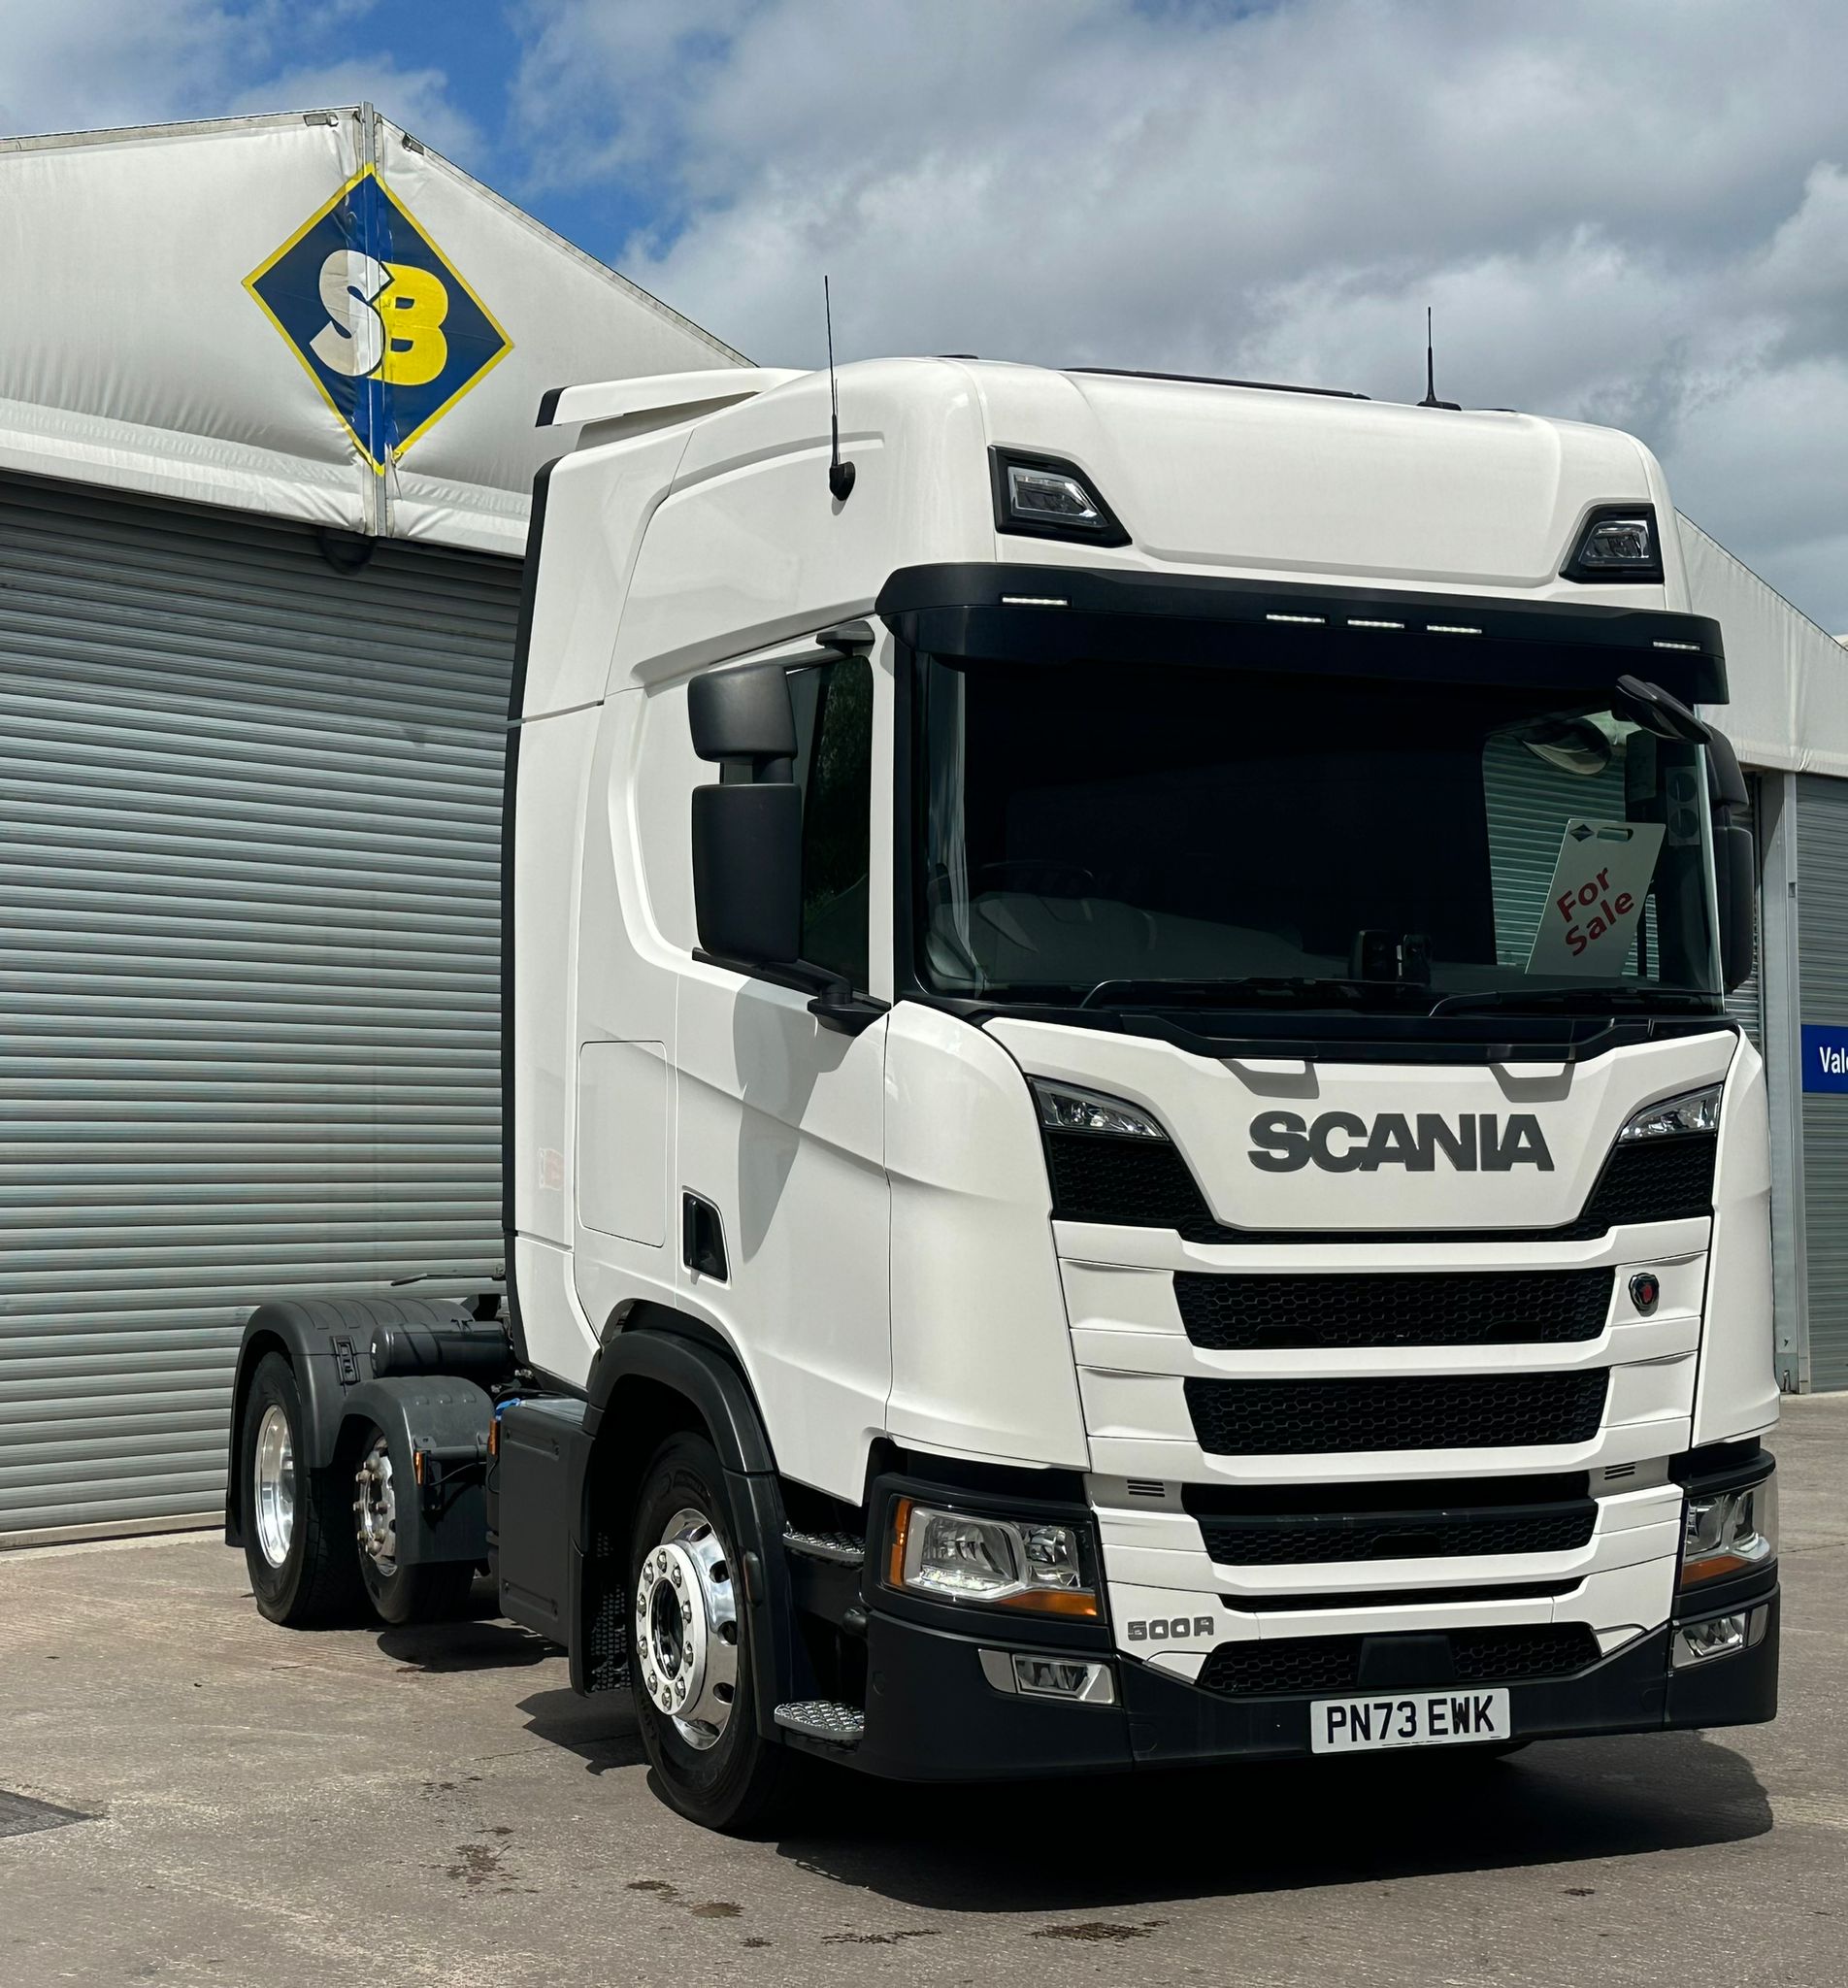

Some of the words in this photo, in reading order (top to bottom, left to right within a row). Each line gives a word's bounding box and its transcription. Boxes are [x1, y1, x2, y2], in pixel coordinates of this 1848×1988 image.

[309, 248, 448, 386] SB
[1557, 868, 1609, 922] For
[1566, 893, 1634, 956] Sale
[1247, 1110, 1555, 1173] SCANIA
[1127, 1616, 1214, 1640] 500R
[1326, 1701, 1417, 1744] PN73
[1427, 1695, 1495, 1737] EWK
